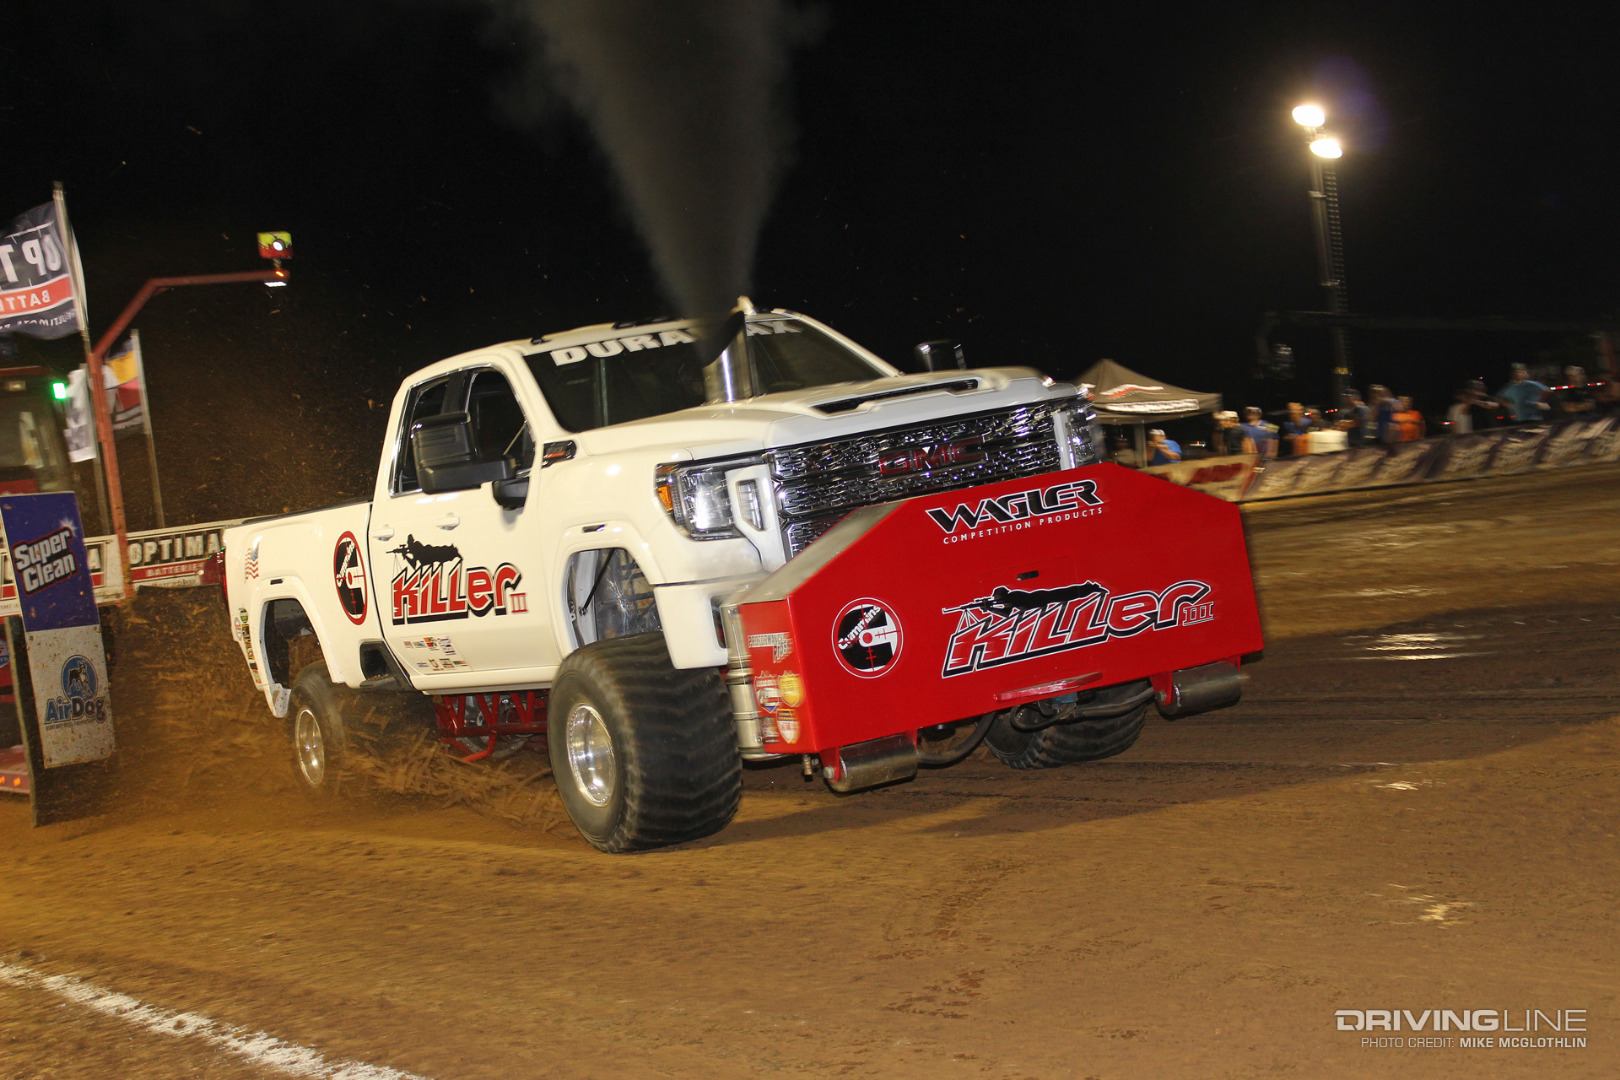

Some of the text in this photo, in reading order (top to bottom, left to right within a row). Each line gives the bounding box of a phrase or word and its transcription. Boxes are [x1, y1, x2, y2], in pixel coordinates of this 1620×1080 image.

[550, 321, 801, 366] DURAAX
[879, 439, 984, 475] GMC
[925, 479, 1104, 534] WAGLER
[943, 507, 1103, 544] COMPETITION PRODUCTS
[14, 530, 71, 570] Super
[128, 533, 220, 565] OPTIMA
[23, 554, 76, 592] Clean
[1182, 602, 1214, 626] III
[45, 696, 106, 724] AirDog
